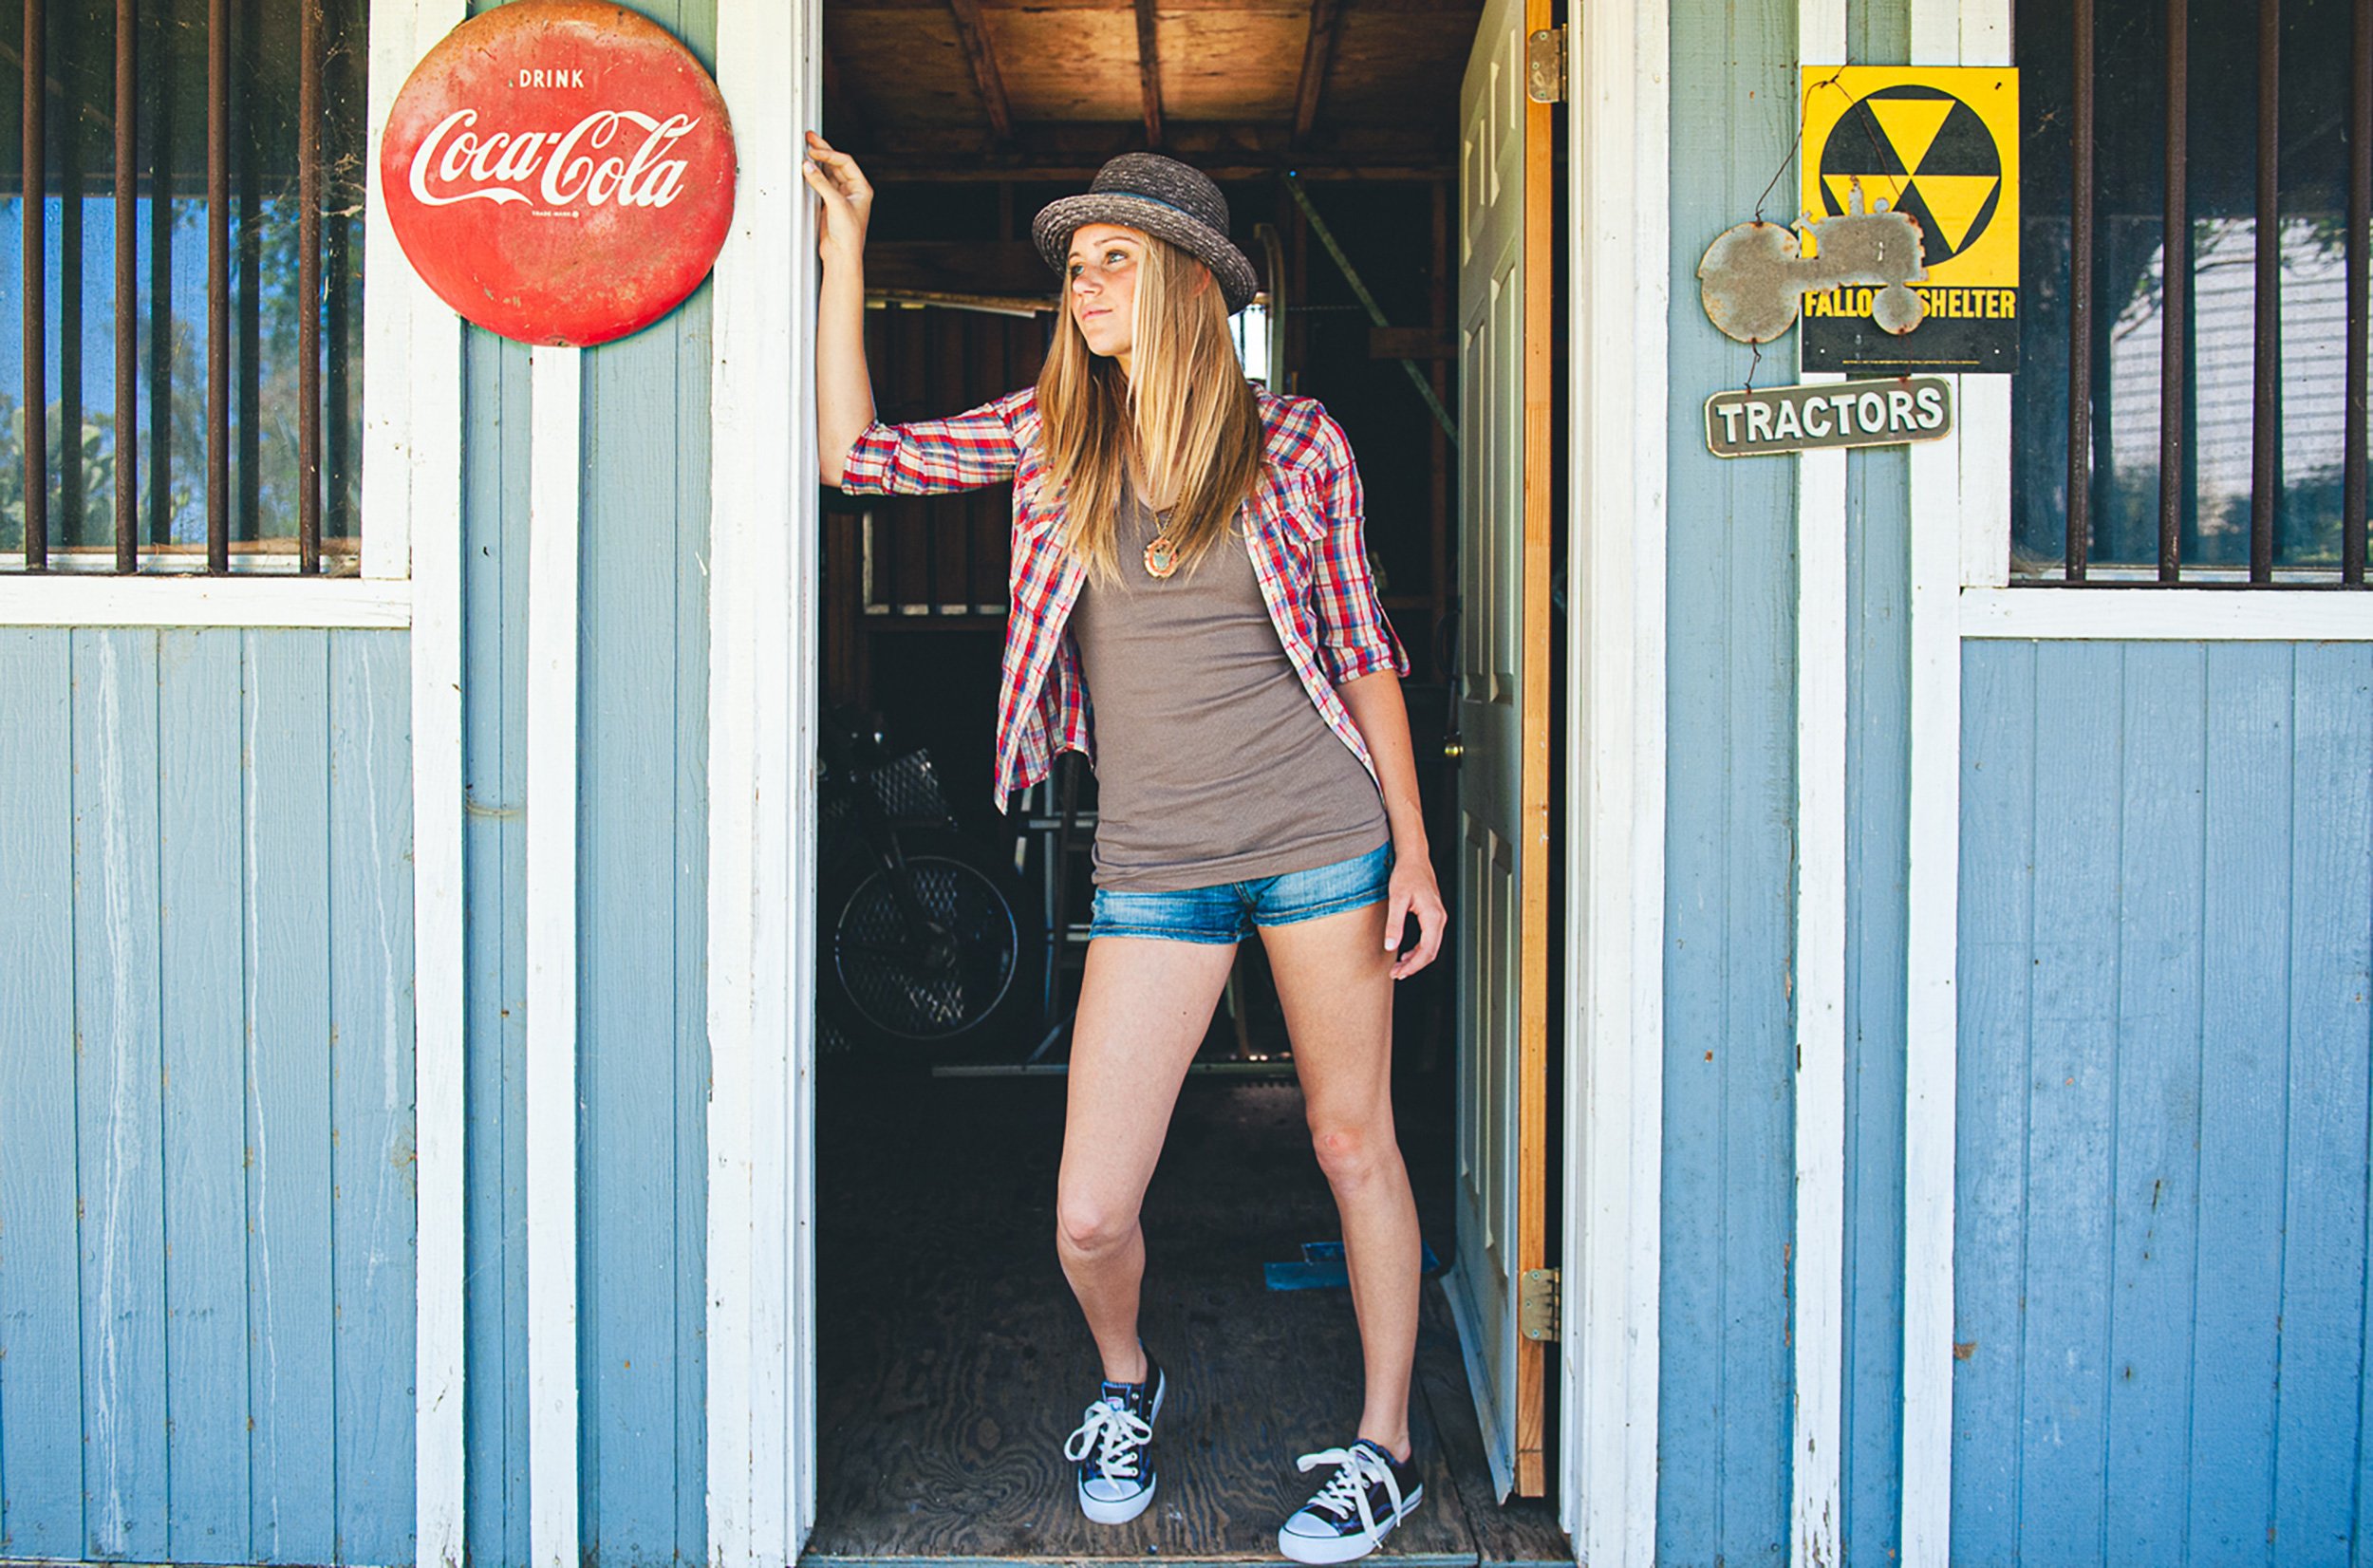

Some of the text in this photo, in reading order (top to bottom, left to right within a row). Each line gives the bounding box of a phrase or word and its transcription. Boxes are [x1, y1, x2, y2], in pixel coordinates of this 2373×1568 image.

[519, 69, 584, 87] DRINK
[409, 108, 701, 208] Coca-Cola
[1804, 288, 1881, 318] FALLO
[1715, 386, 1944, 443] TRACTORS
